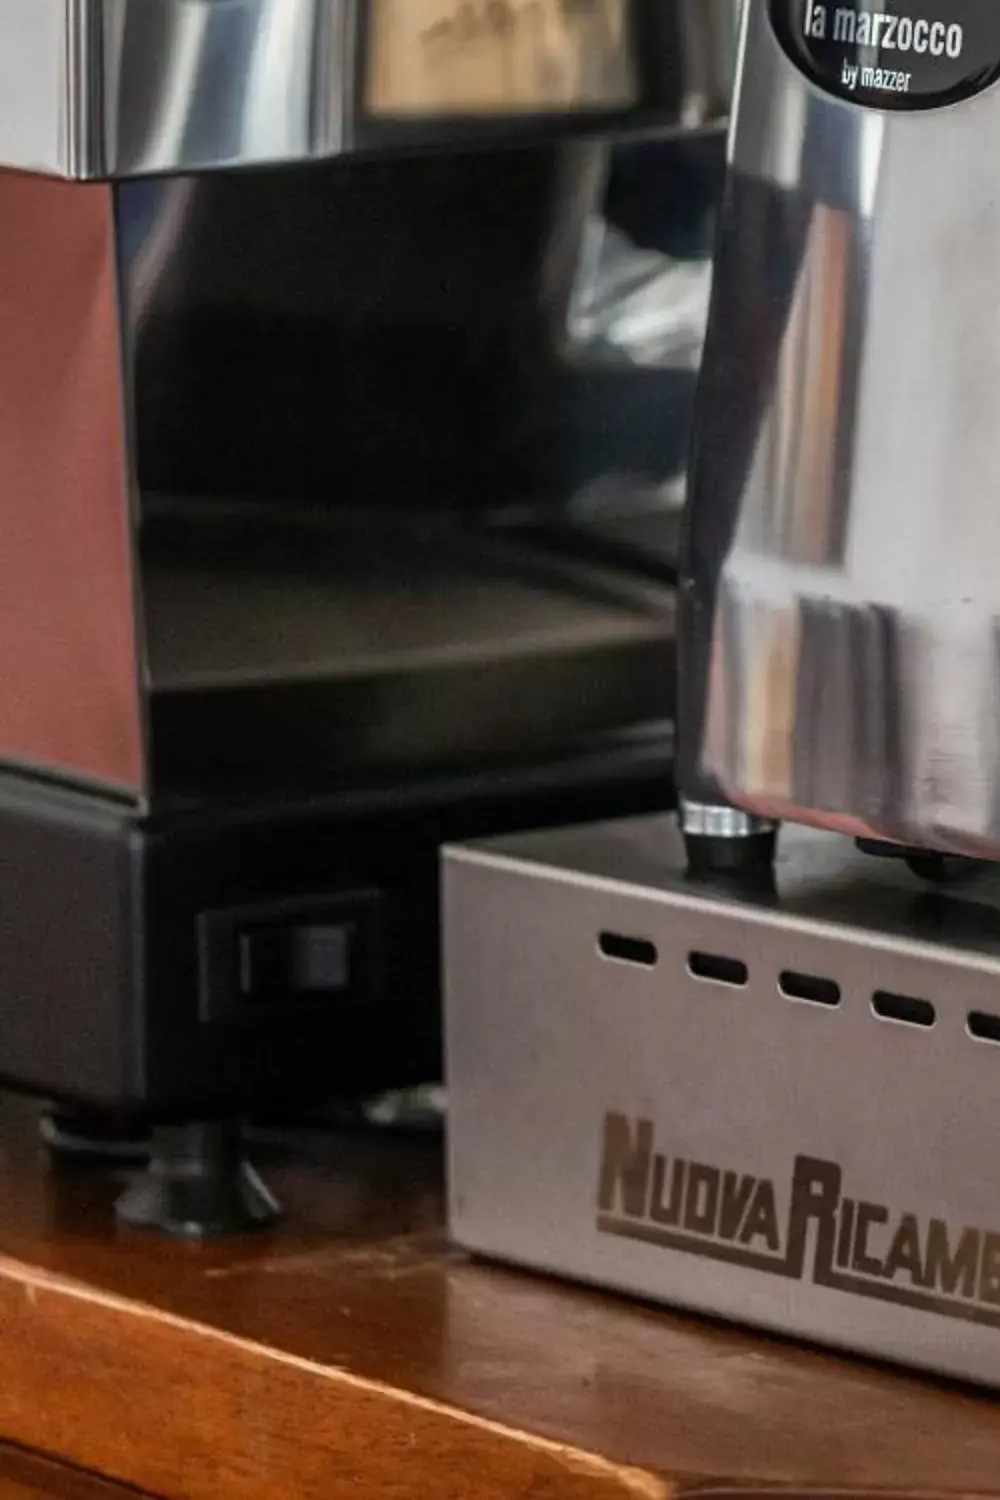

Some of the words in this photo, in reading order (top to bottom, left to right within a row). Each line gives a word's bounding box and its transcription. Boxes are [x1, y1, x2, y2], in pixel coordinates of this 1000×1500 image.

[833, 7, 962, 58] marzocco
[841, 58, 857, 89] by
[861, 66, 911, 92] mazzer
